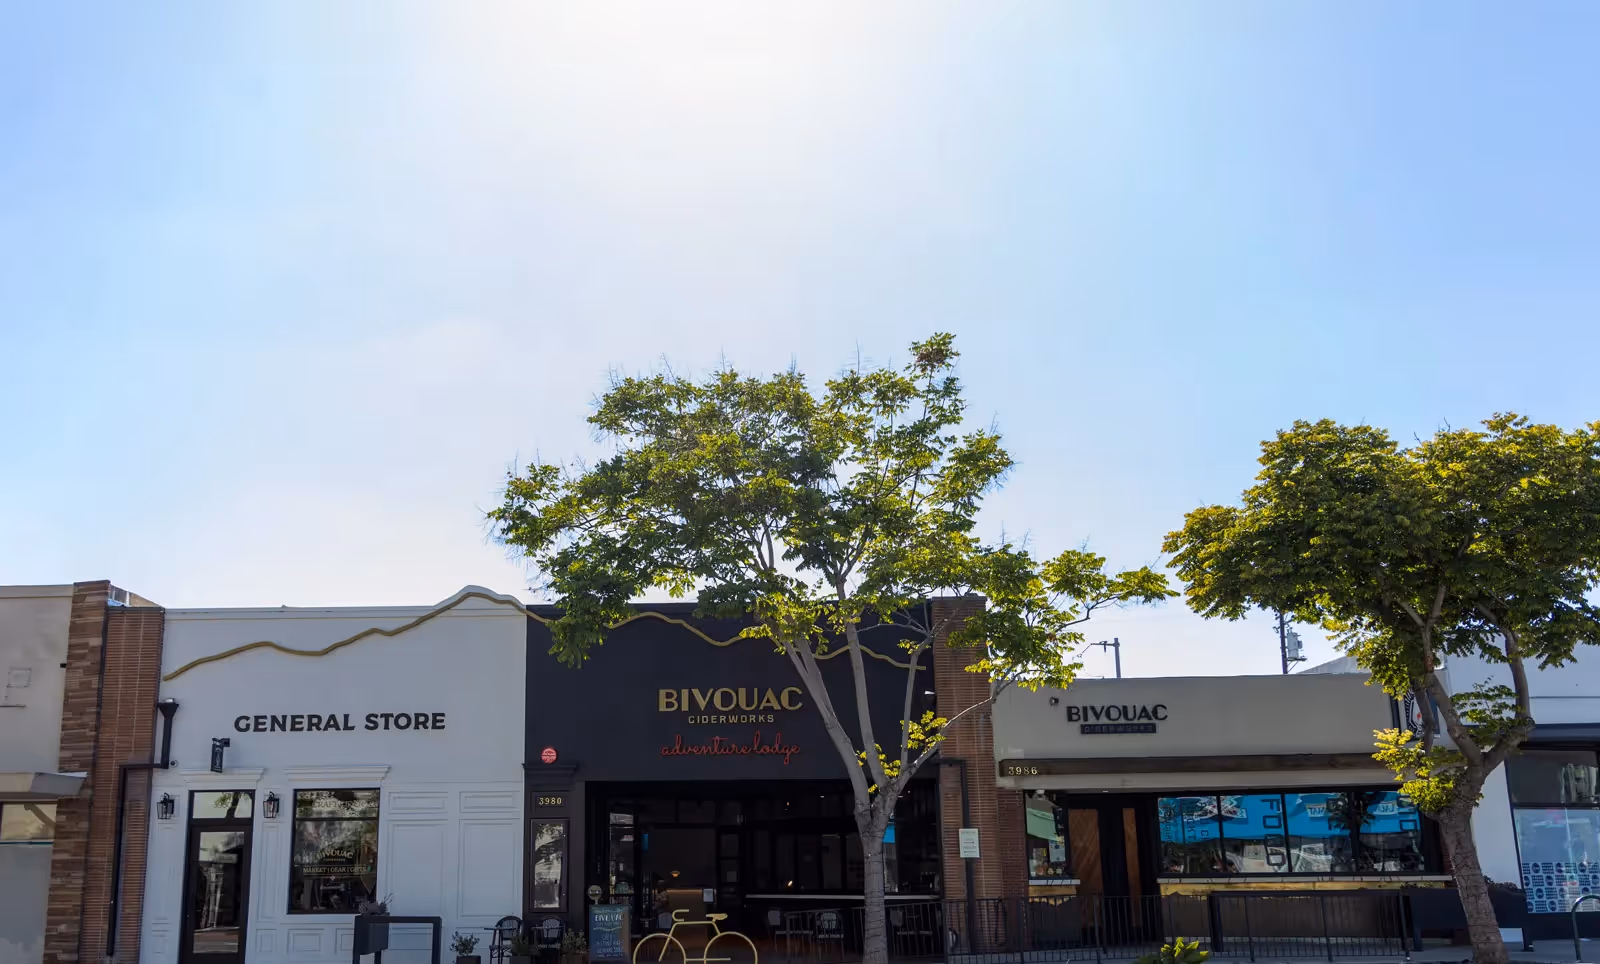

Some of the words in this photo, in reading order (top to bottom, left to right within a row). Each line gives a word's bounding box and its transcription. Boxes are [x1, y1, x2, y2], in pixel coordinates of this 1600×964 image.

[658, 686, 803, 712] BIVOUAC
[1066, 704, 1168, 722] BIVOUAC
[234, 714, 356, 732] GENERAL
[364, 712, 446, 731] STORE
[688, 714, 775, 724] CIDERWORKS
[661, 734, 751, 756] adventure
[752, 730, 800, 765] lodge
[1008, 766, 1038, 776] 3986
[538, 797, 562, 806] 3980
[316, 848, 354, 859] BIVOUAC
[330, 866, 346, 874] GEAR
